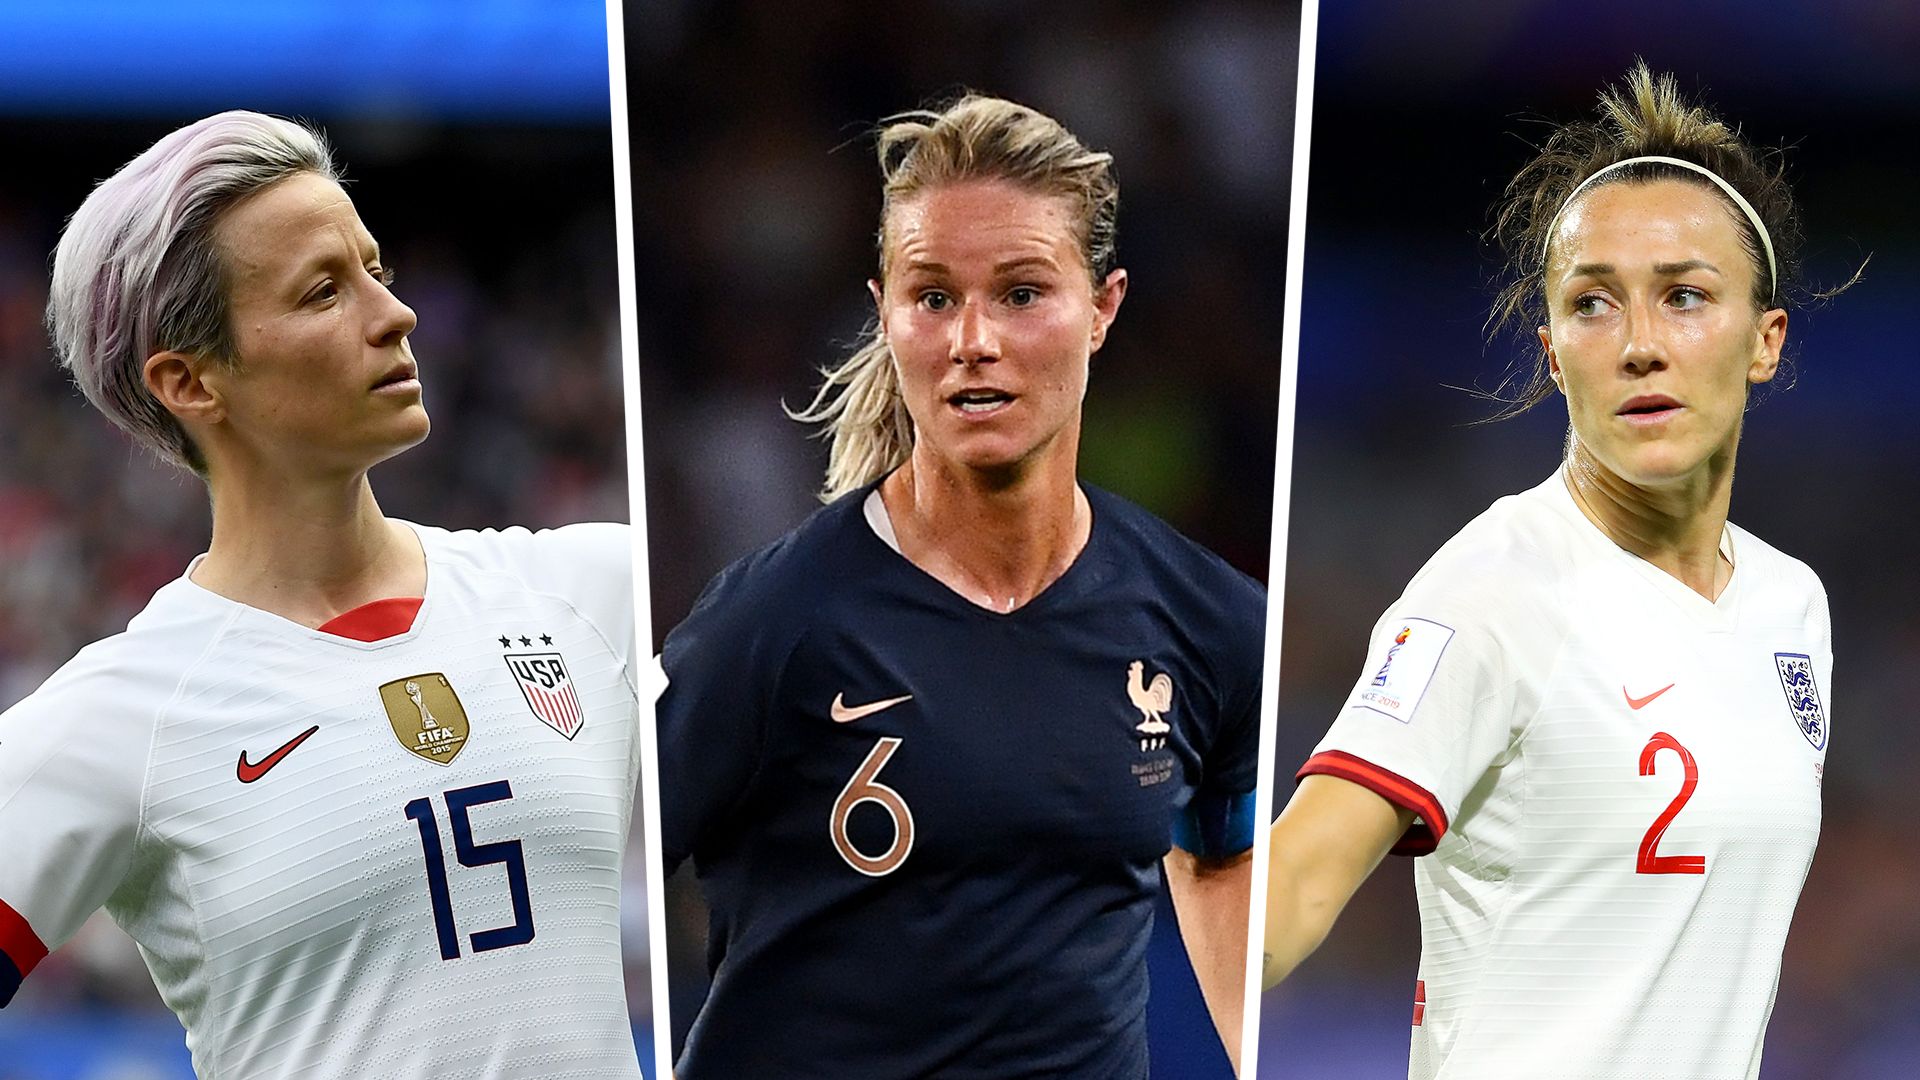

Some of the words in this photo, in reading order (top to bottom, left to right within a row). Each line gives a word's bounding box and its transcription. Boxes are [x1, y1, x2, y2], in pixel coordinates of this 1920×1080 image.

[513, 660, 566, 689] USA
[413, 743, 433, 751] WORLD
[417, 727, 453, 744] FIFA
[430, 745, 451, 755] 2015
[829, 736, 915, 877] 6
[1636, 731, 1706, 875] 2
[404, 779, 536, 961] 15
